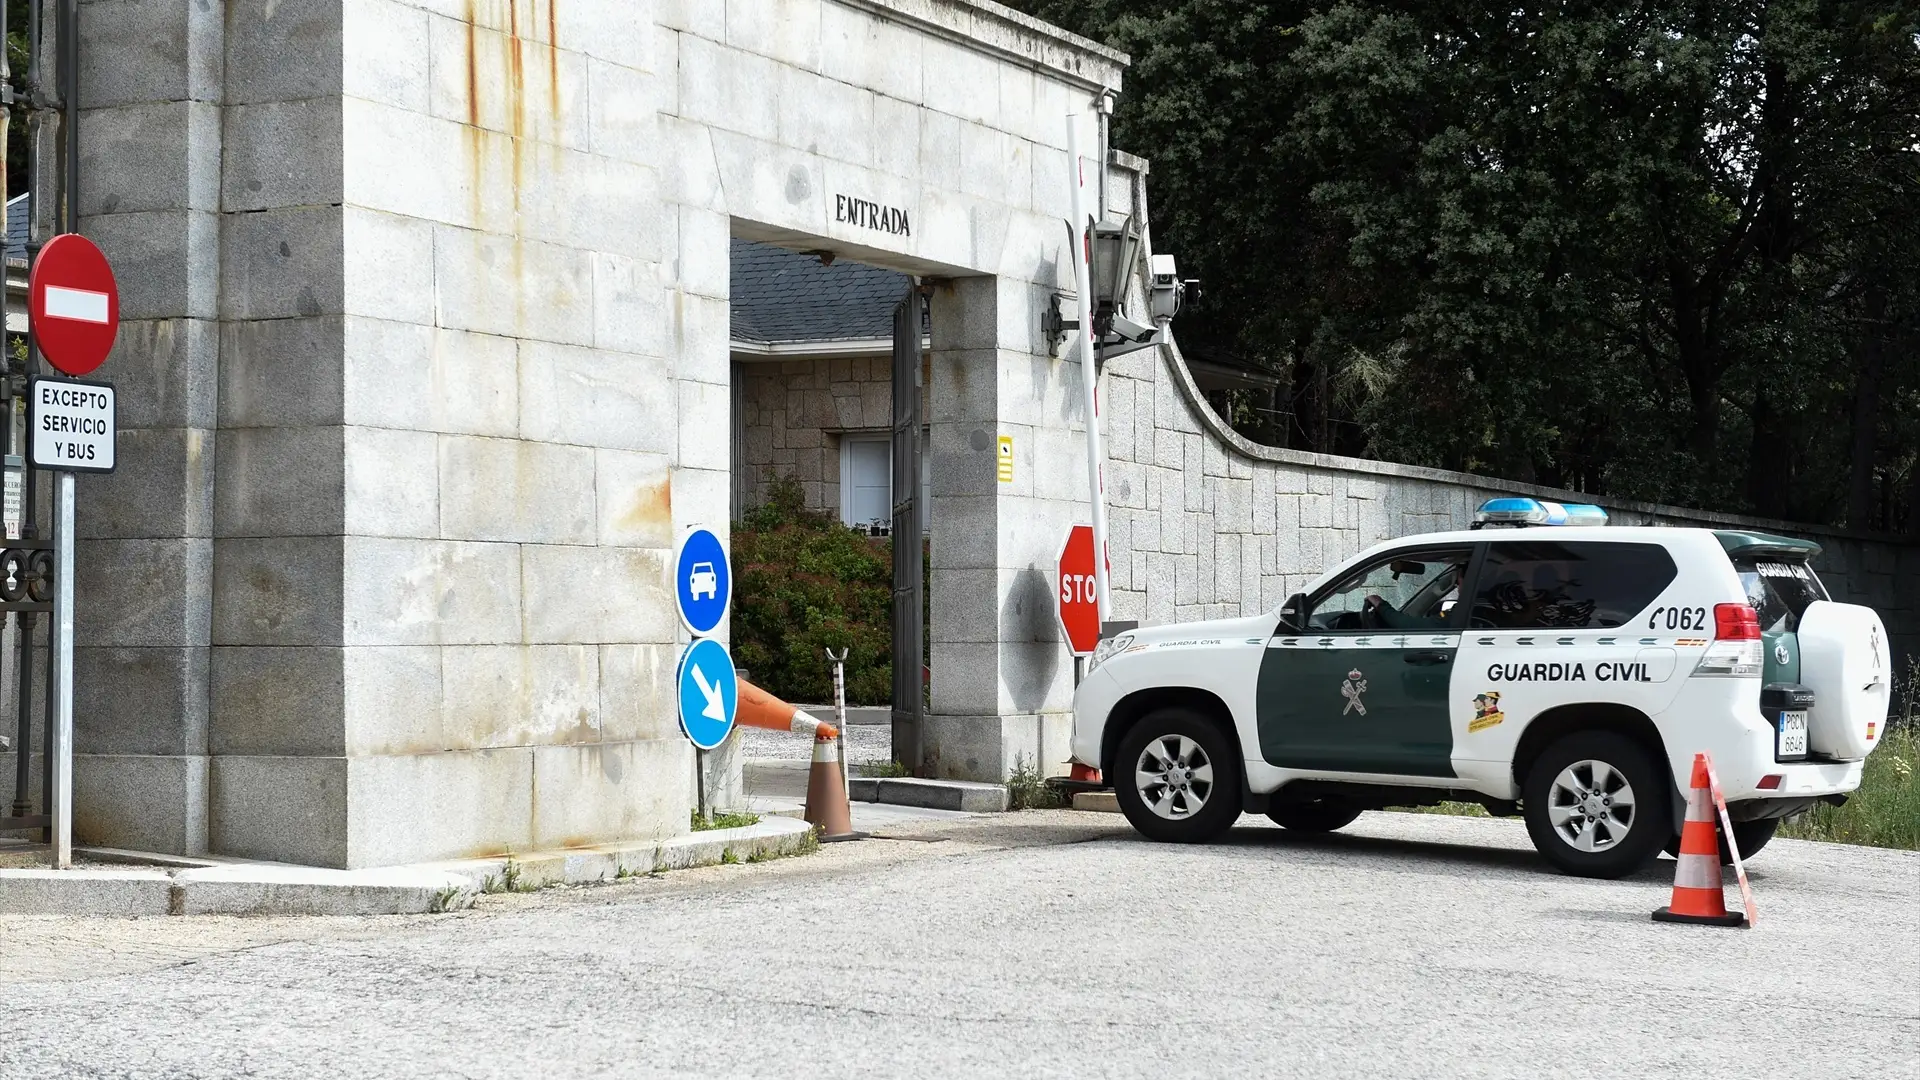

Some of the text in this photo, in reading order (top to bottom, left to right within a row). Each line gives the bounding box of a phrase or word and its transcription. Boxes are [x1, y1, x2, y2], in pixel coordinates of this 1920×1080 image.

[836, 194, 910, 236] ENTRADA
[42, 388, 107, 409] EXCEPTO
[42, 415, 106, 435] SERVICIO
[55, 442, 95, 460] Y BUS
[1061, 573, 1096, 604] STO
[1666, 607, 1706, 631] 062
[1159, 640, 1197, 648] GUARDIA
[1487, 662, 1651, 682] GUARDIA CIVIL
[1786, 714, 1805, 730] PGCN
